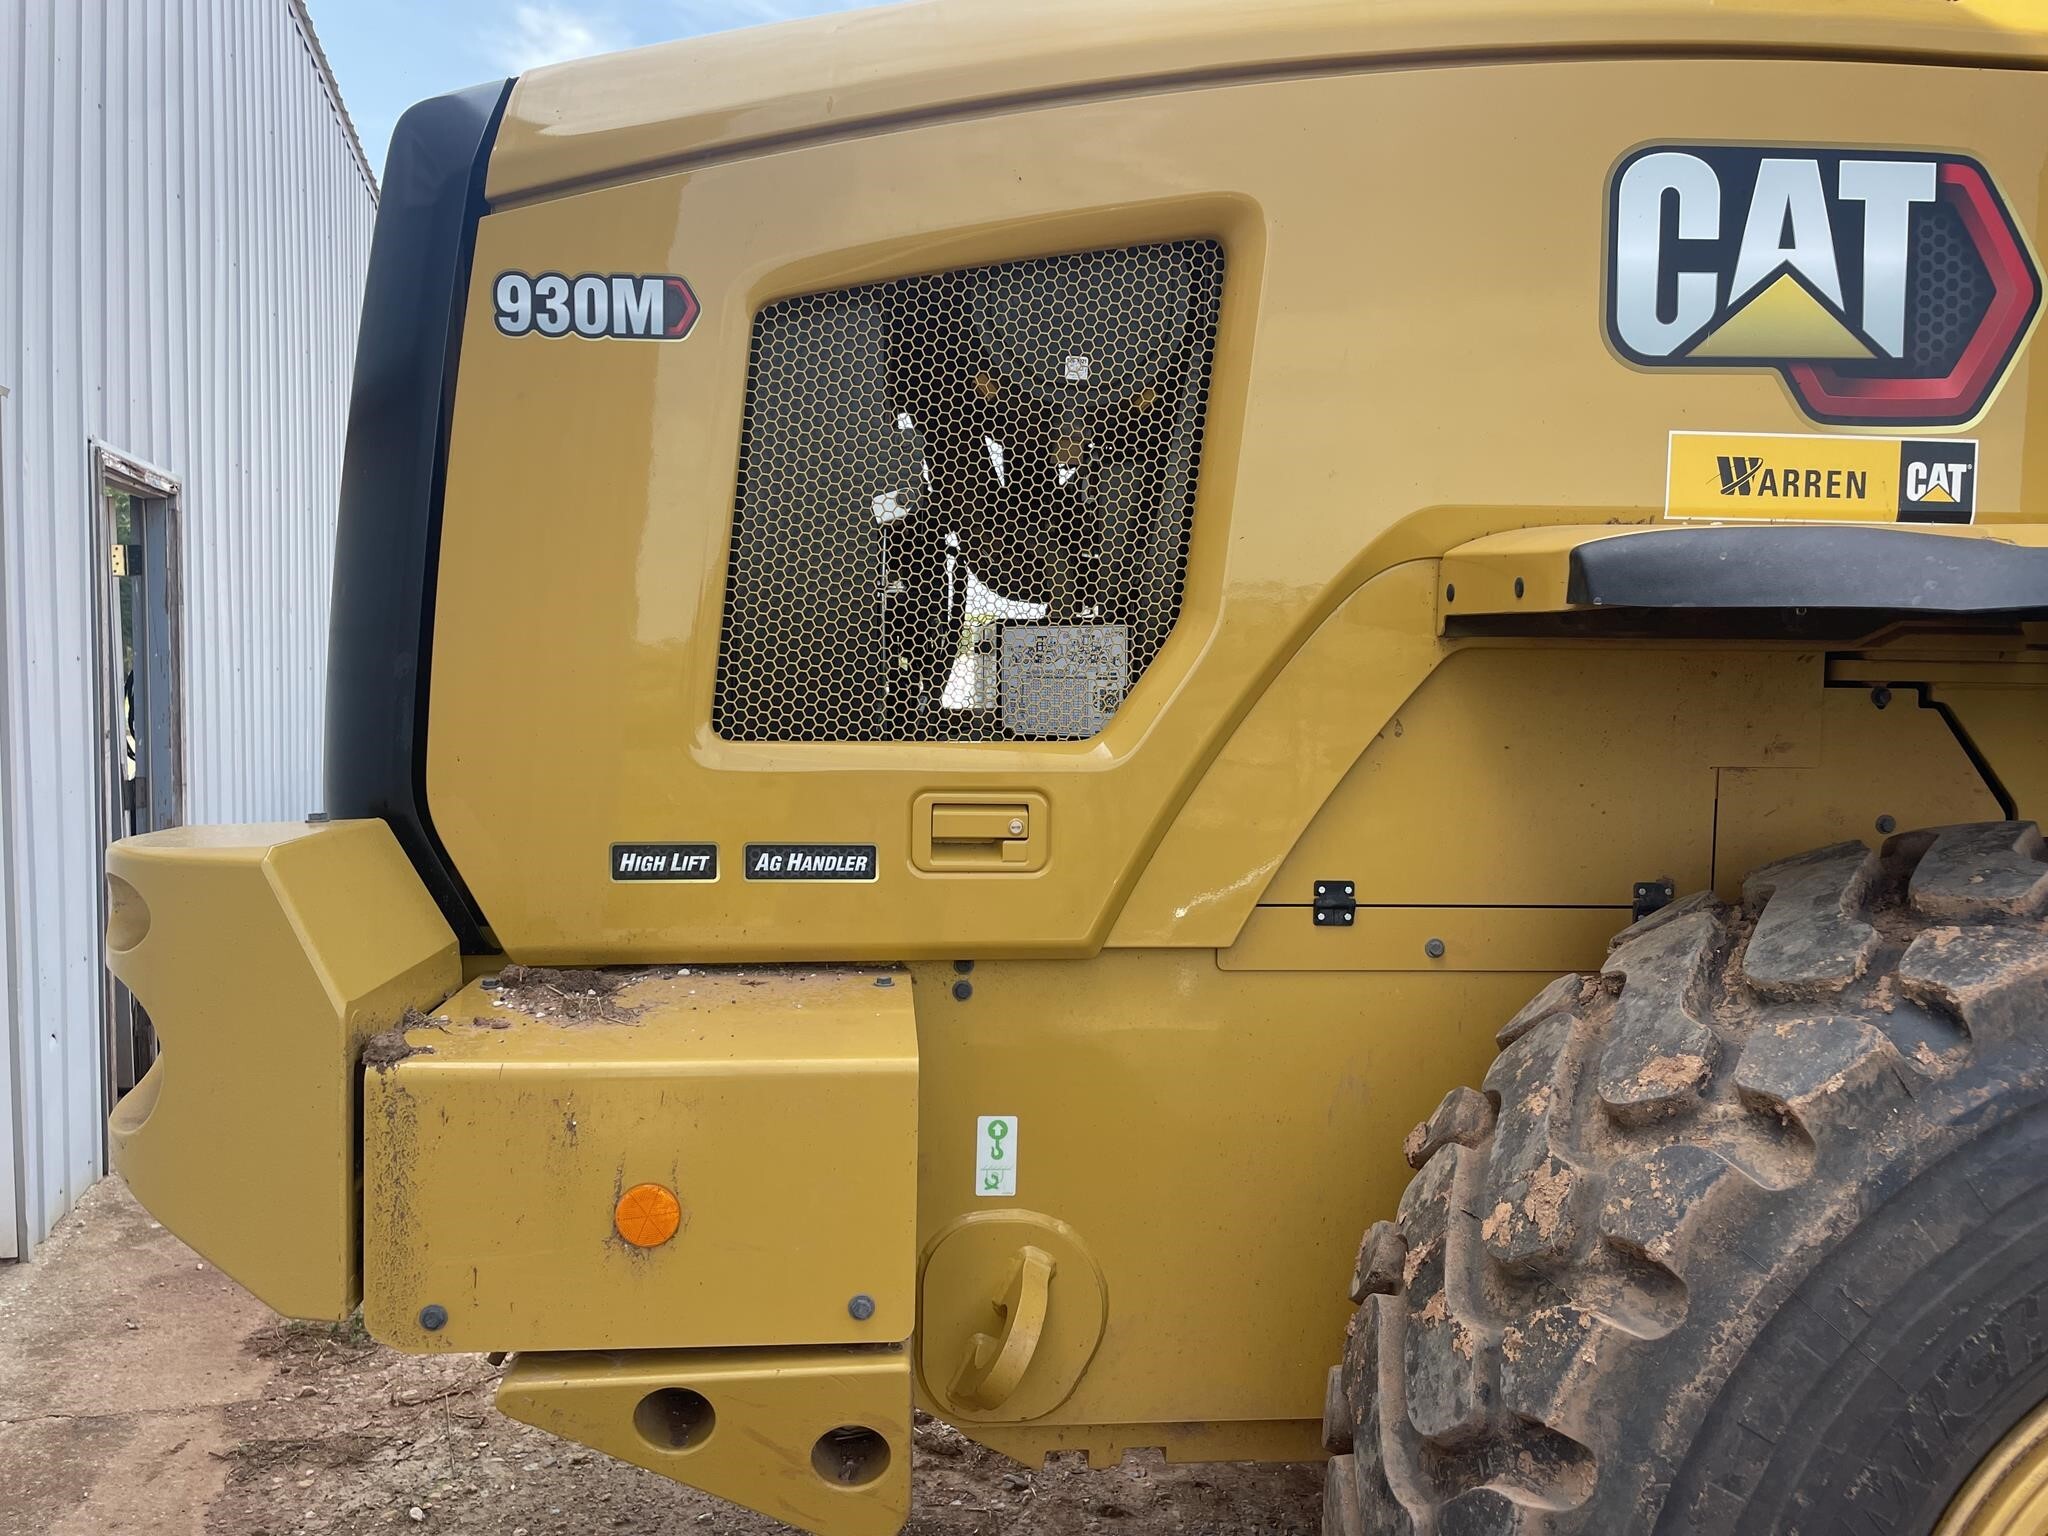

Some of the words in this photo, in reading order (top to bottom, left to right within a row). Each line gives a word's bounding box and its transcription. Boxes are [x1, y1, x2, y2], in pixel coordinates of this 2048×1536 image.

[1616, 152, 1937, 358] CAT
[496, 274, 664, 335] 930M
[1714, 455, 1867, 500] WARREN
